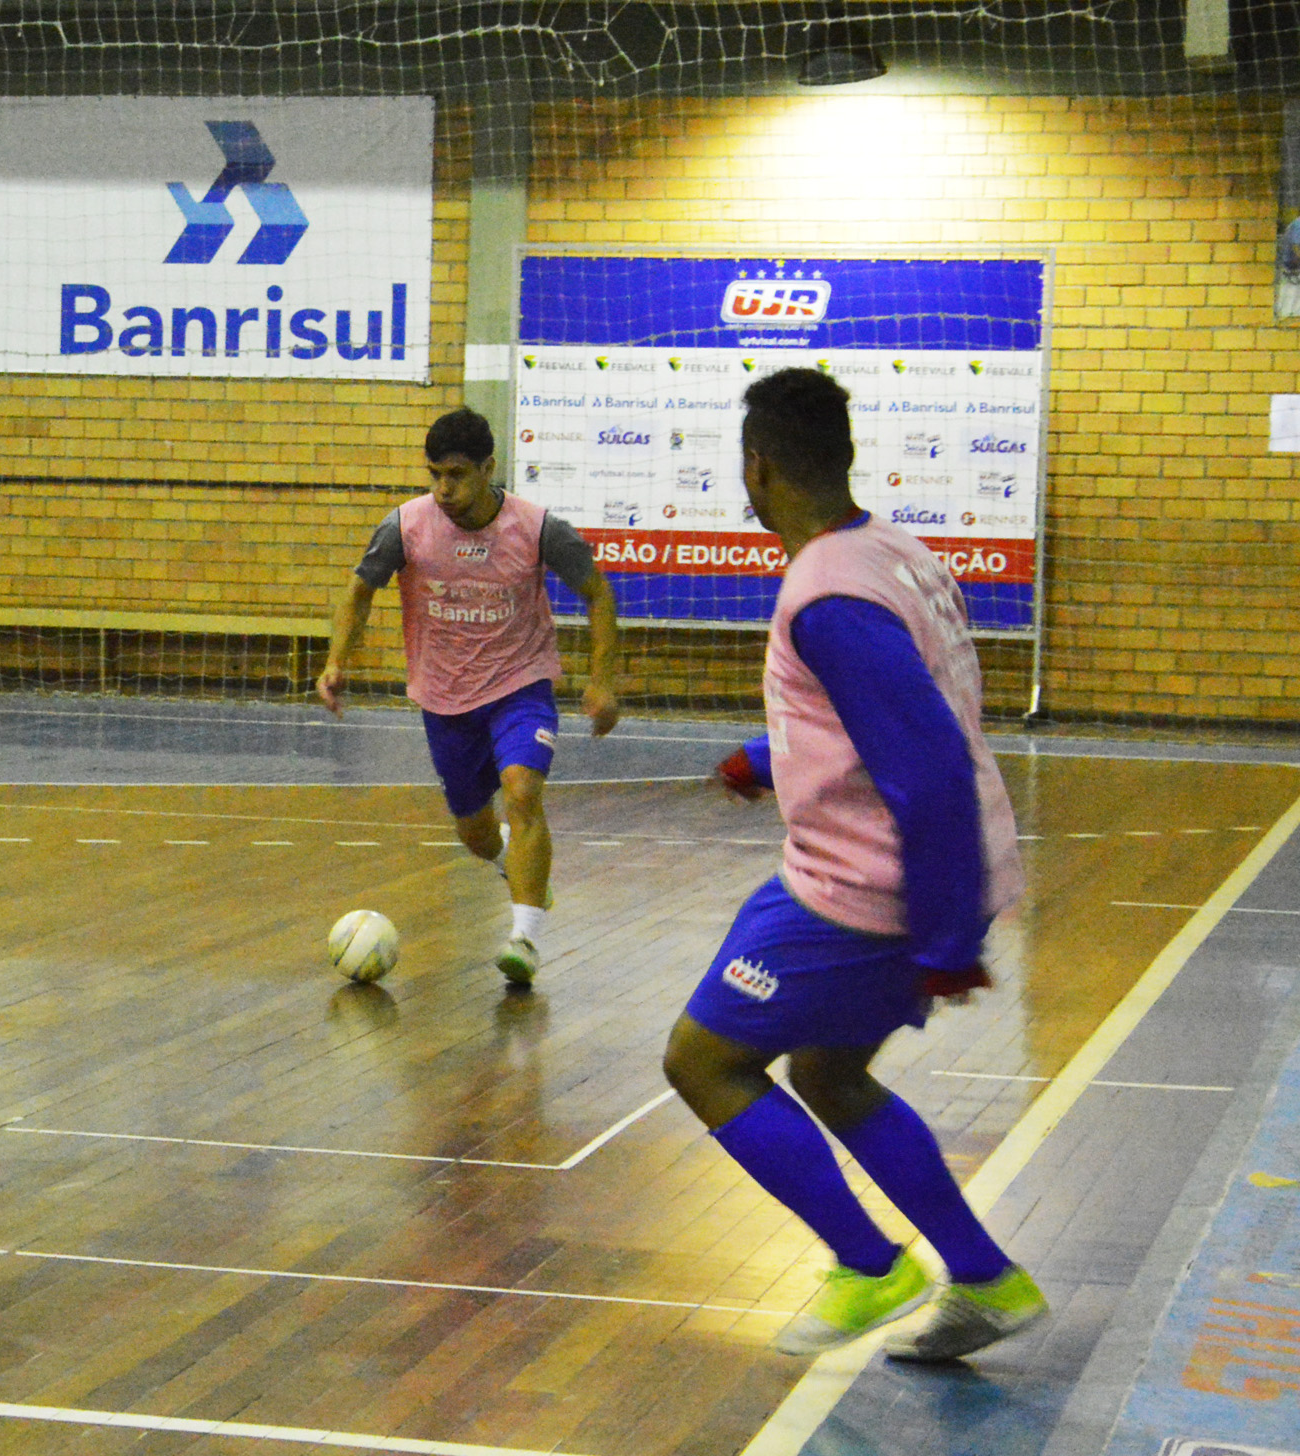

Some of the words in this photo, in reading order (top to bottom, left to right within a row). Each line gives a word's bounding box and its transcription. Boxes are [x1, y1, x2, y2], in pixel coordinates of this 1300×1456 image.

[732, 289, 818, 315] UJR
[60, 283, 407, 360] Banrisul
[532, 395, 586, 408] Banrisul
[604, 396, 658, 409] Banrisul
[677, 397, 732, 410] Banrisul
[902, 400, 957, 413] Banrisul
[979, 401, 1035, 415] Banrisul
[676, 545, 790, 571] EDUCAÇ
[428, 599, 515, 623] Banrisul
